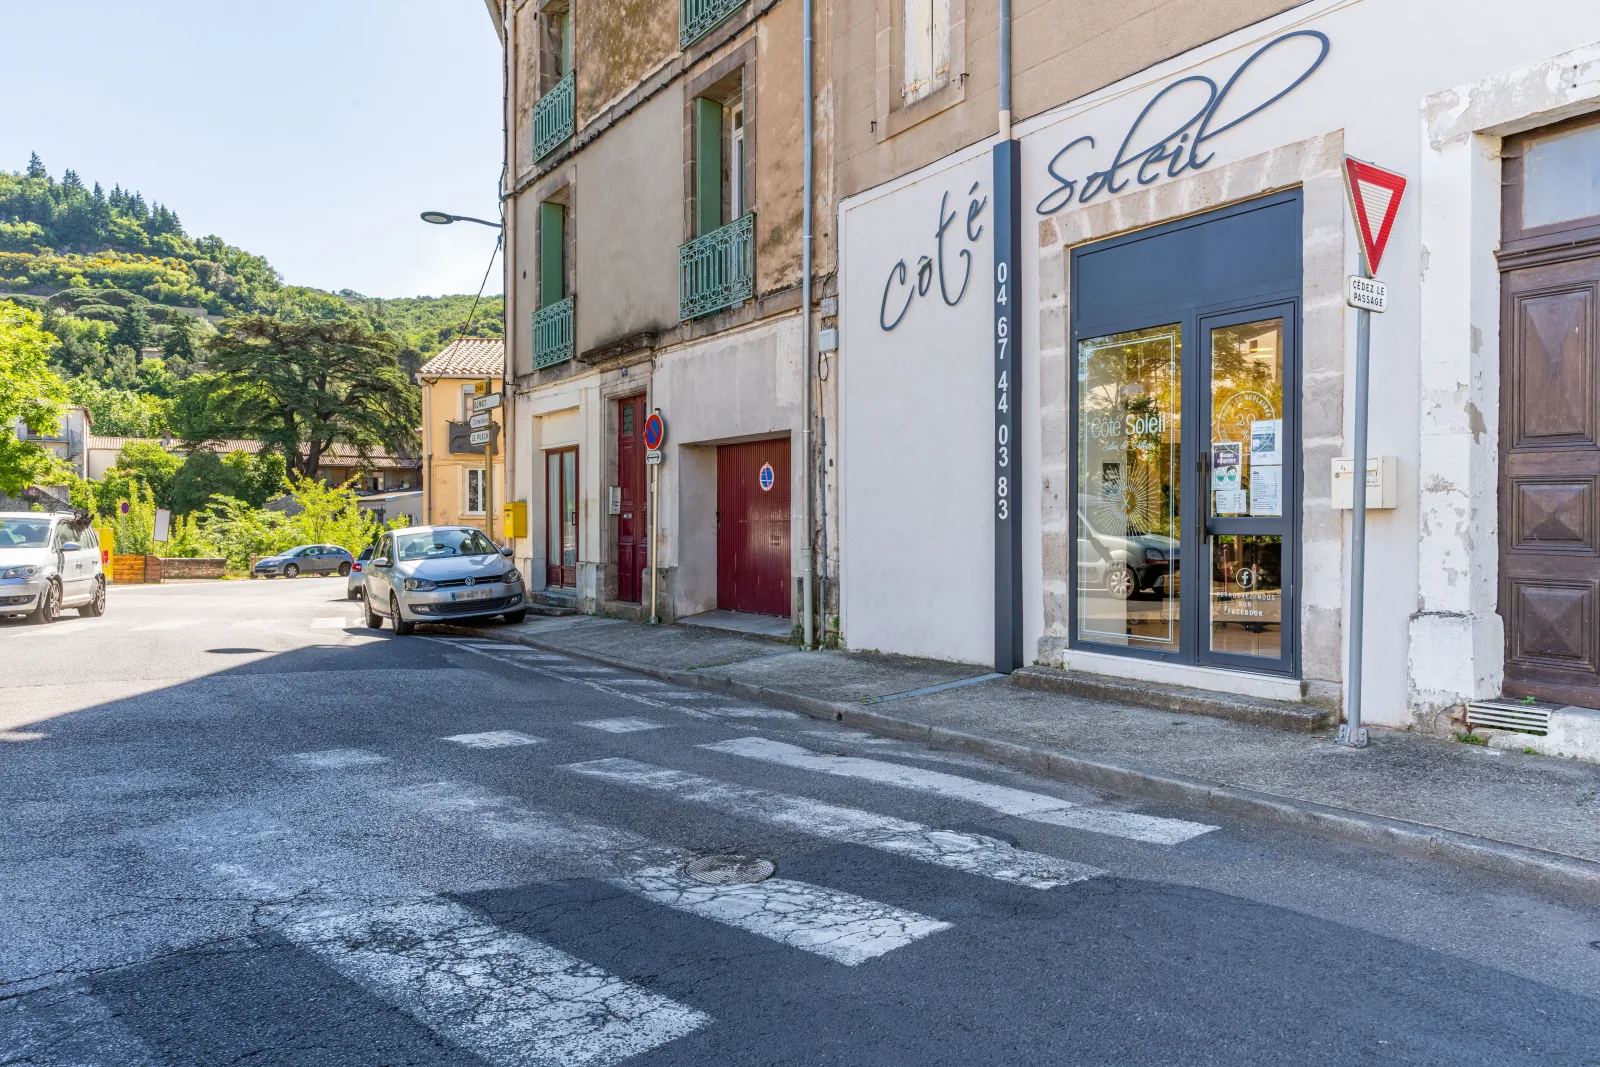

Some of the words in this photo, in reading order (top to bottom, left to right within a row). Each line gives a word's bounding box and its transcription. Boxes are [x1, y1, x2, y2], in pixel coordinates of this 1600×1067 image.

[880, 181, 987, 331] Côté
[1036, 30, 1330, 215] Soleil
[997, 262, 1008, 305] 04
[1352, 279, 1374, 294] CÉDEZ
[1376, 285, 1385, 296] LE
[1353, 292, 1383, 307] PASSAGE
[997, 316, 1008, 360] 67
[997, 370, 1008, 413] 44
[1091, 416, 1121, 438] Côté
[1125, 411, 1166, 436] Soleil
[1235, 413, 1256, 427] 20
[998, 424, 1009, 467] 03
[997, 476, 1008, 520] 83
[1227, 608, 1263, 617] FACEBOOK
[1238, 600, 1252, 608] SUR
